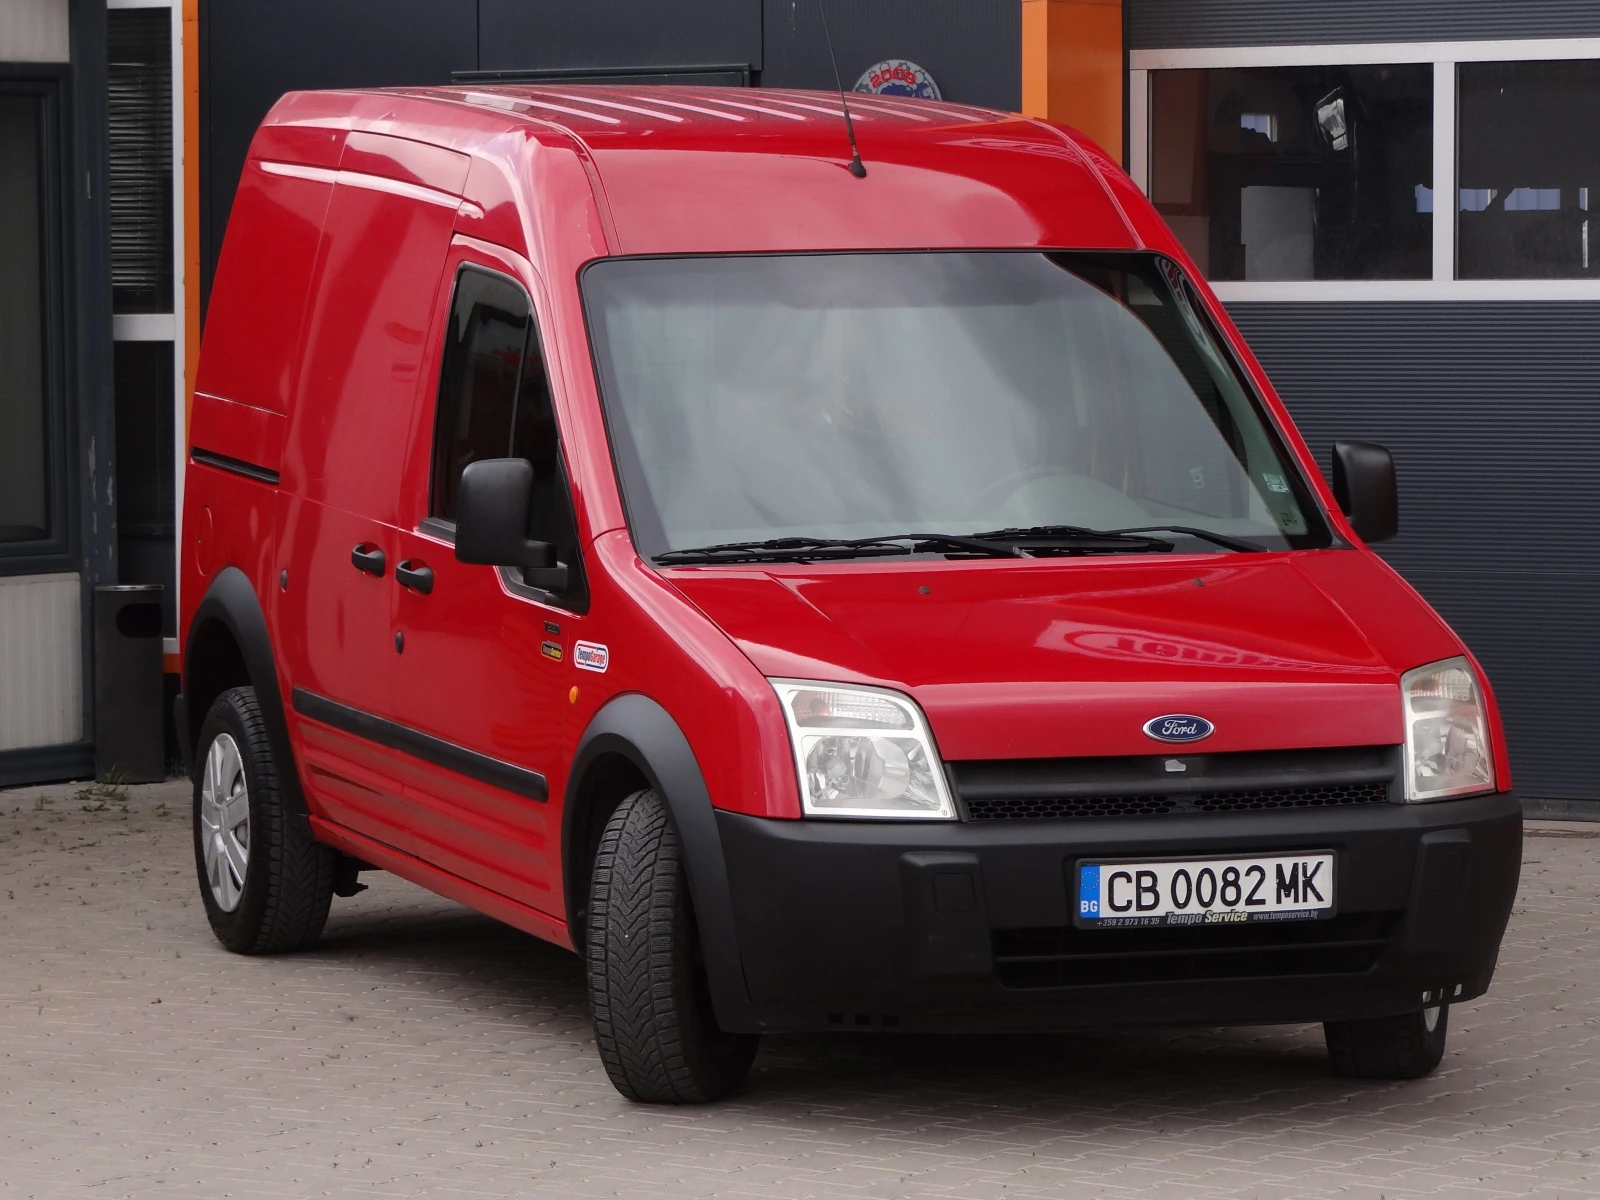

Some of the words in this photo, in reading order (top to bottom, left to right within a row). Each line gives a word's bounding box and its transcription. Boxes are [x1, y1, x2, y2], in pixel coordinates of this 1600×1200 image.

[1162, 719, 1197, 735] Ford
[1108, 870, 1160, 912] CB
[1170, 865, 1267, 910] 0082
[1276, 861, 1325, 905] MK
[1080, 900, 1099, 913] BG
[1097, 918, 1116, 927] +359
[1124, 918, 1139, 926] 973
[1140, 917, 1149, 925] 16
[1150, 917, 1160, 925] 35
[1166, 912, 1203, 926] Tempo
[1205, 909, 1248, 923] Service
[1253, 910, 1319, 921] www.temposervice.bg
